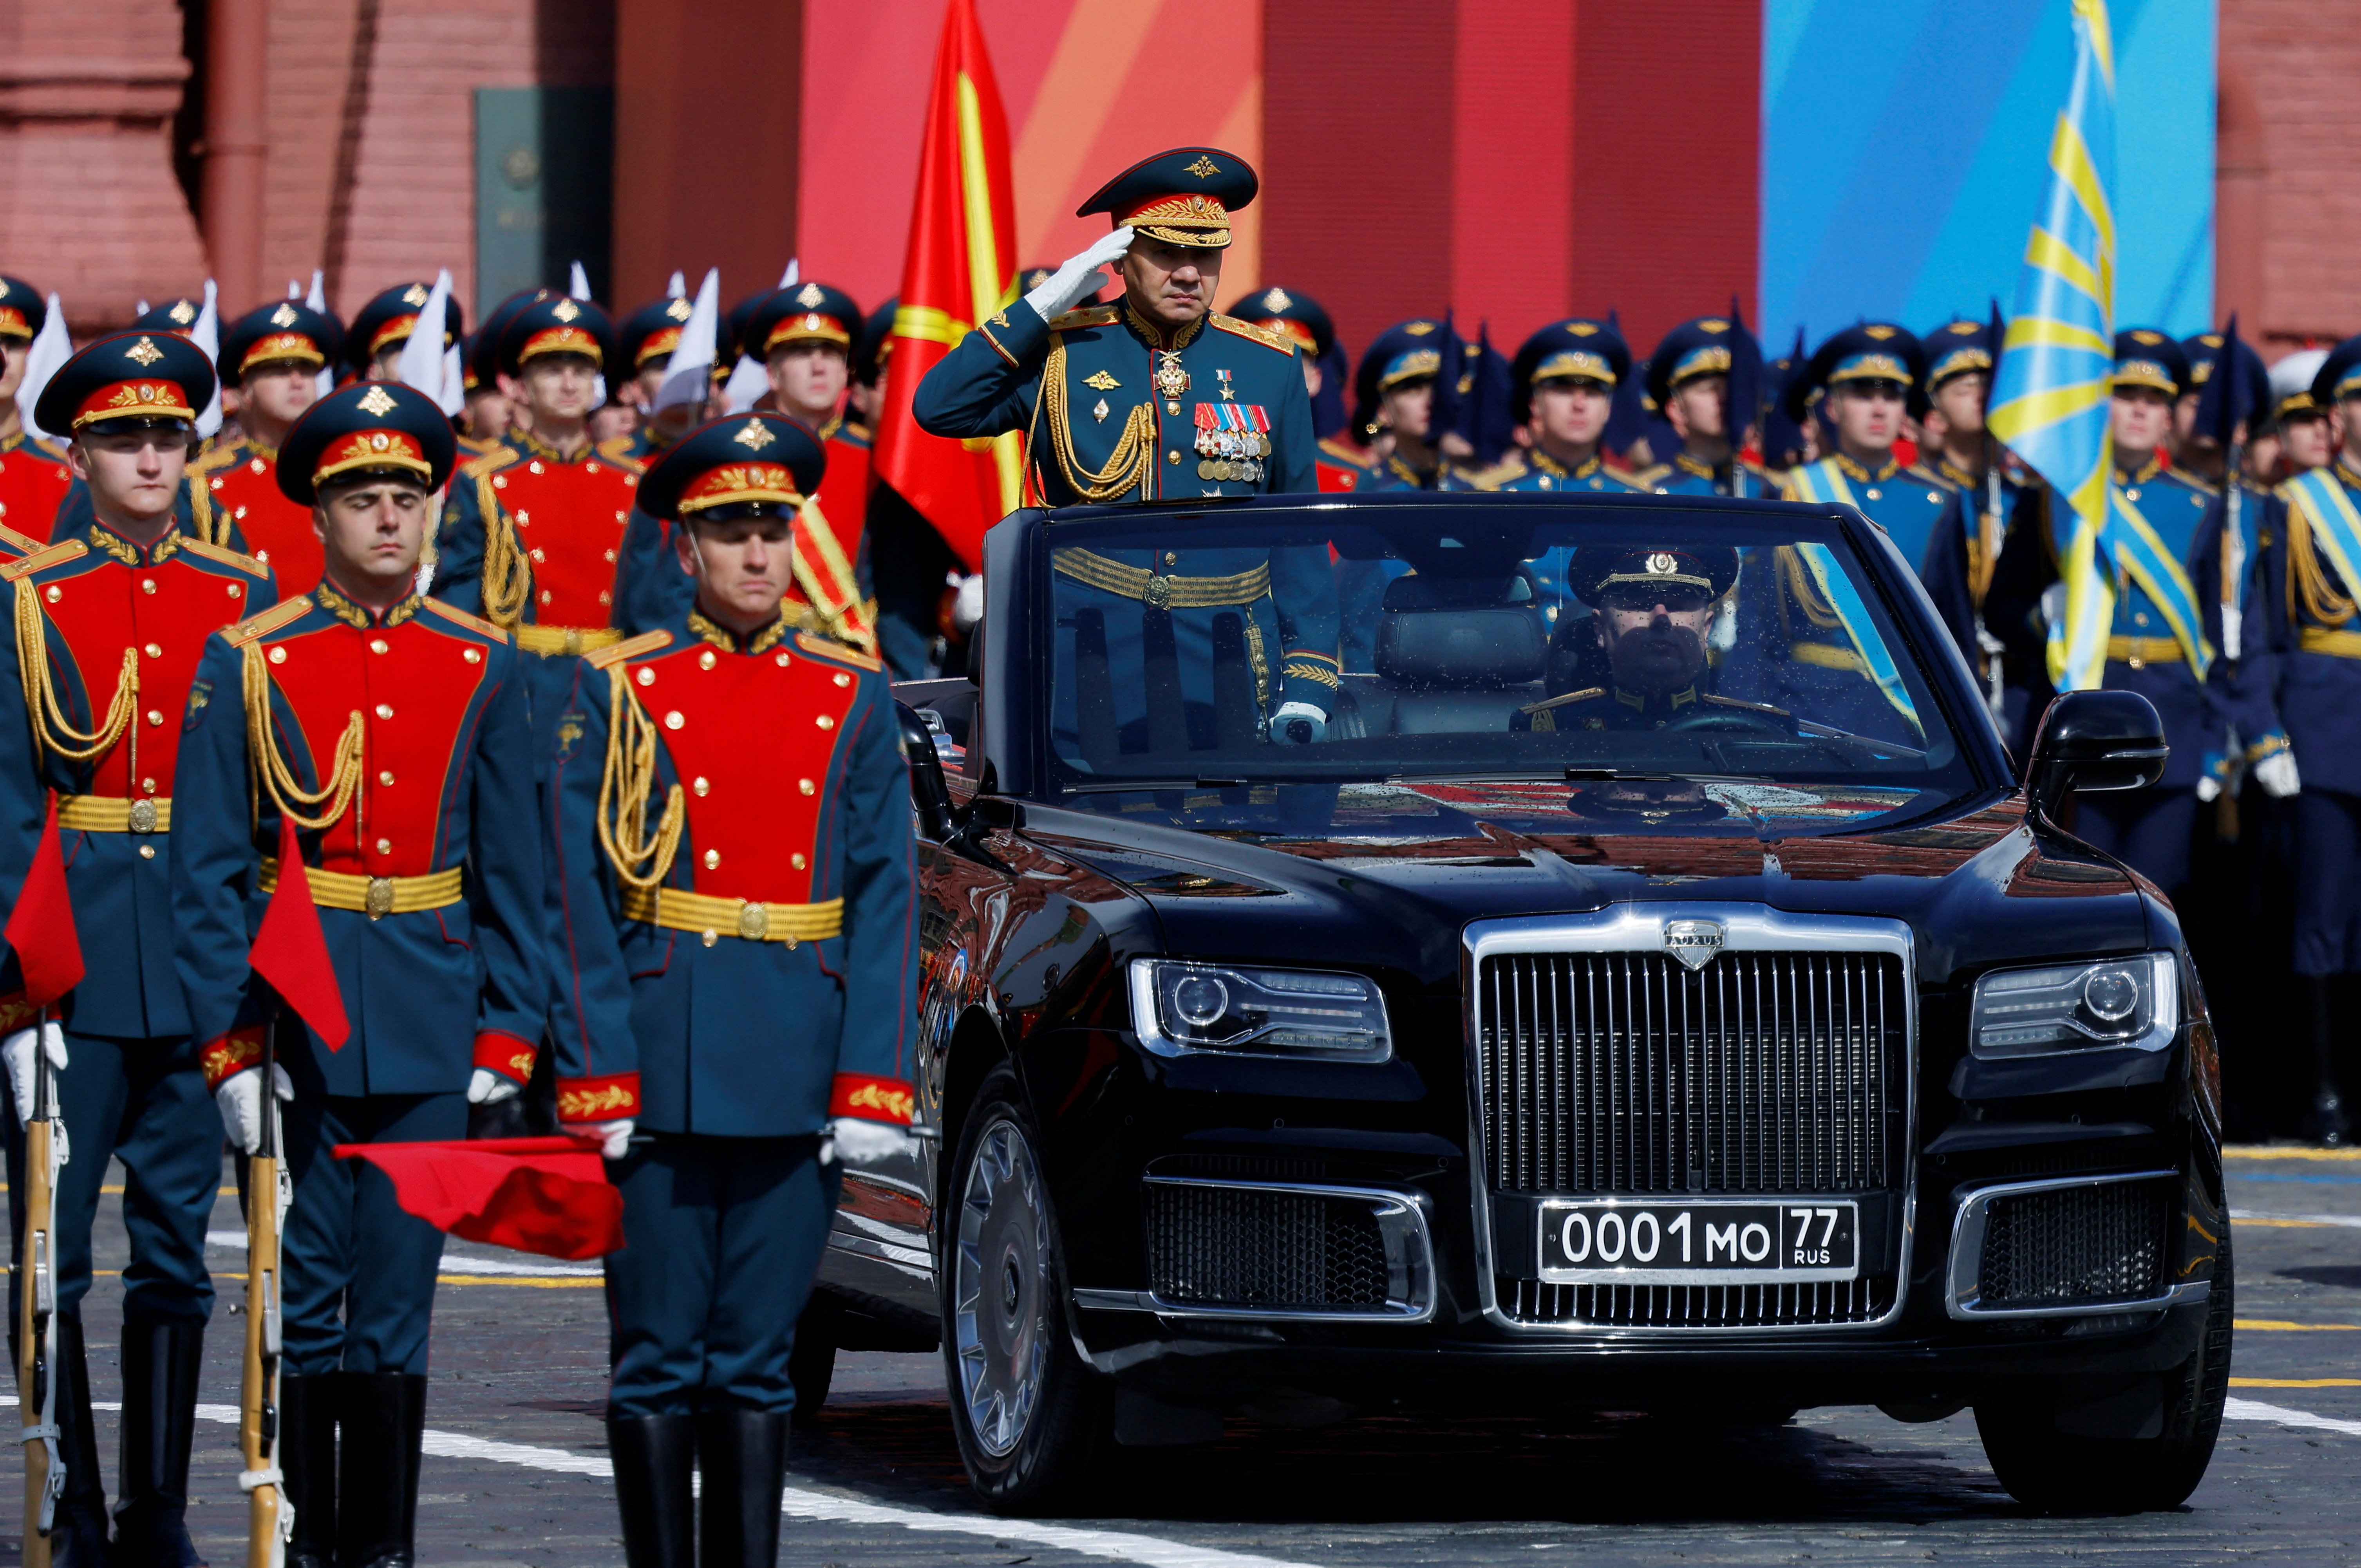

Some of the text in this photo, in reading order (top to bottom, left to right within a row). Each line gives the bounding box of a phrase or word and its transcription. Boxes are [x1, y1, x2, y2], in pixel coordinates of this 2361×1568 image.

[1670, 936, 1721, 945] AURUS
[1790, 1208, 1839, 1247] 77
[1794, 1248, 1831, 1265] RUS
